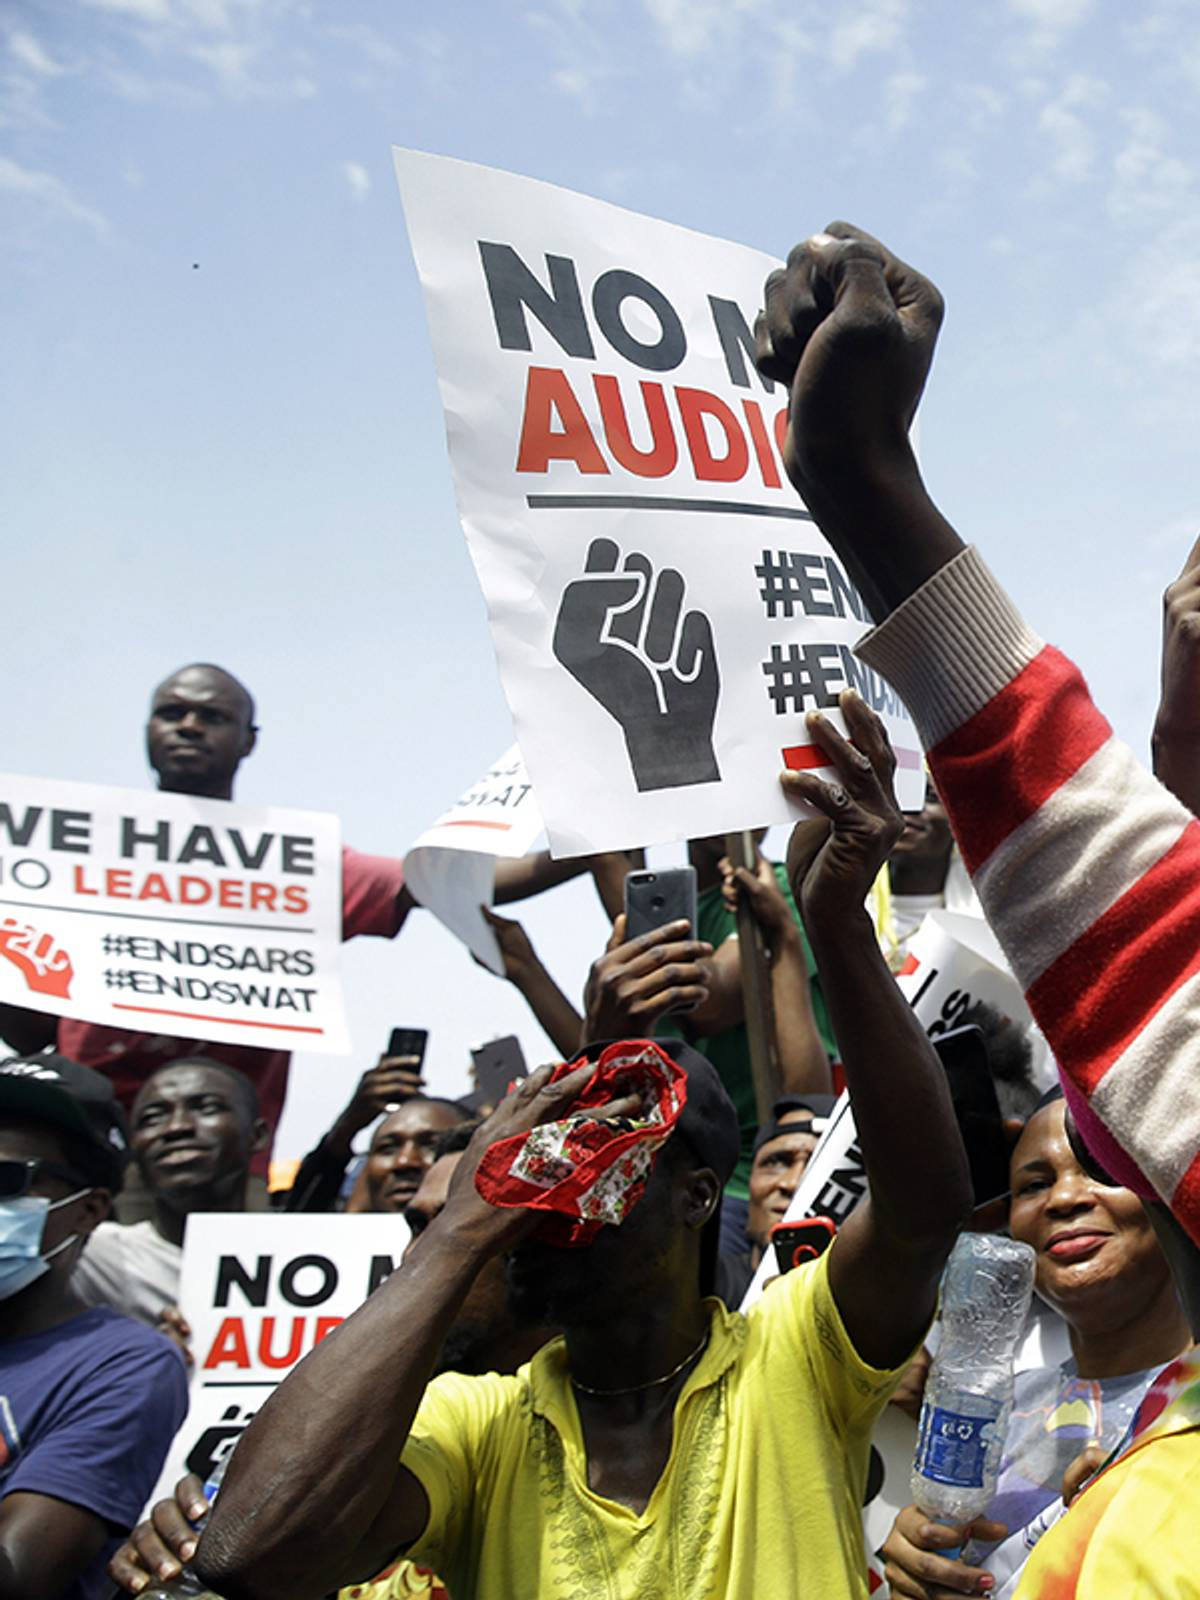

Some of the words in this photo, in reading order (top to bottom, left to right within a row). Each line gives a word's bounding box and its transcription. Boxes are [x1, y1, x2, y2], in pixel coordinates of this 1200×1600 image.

[477, 240, 688, 372] NO
[515, 365, 790, 490] AUDI
[0, 803, 92, 854] WE
[120, 816, 315, 876] HAVE
[0, 855, 51, 890] O
[73, 865, 310, 914] LEADERS
[101, 933, 315, 977] #ENDSARS
[103, 968, 317, 1013] #ENDSWAT
[213, 1254, 339, 1308] NO
